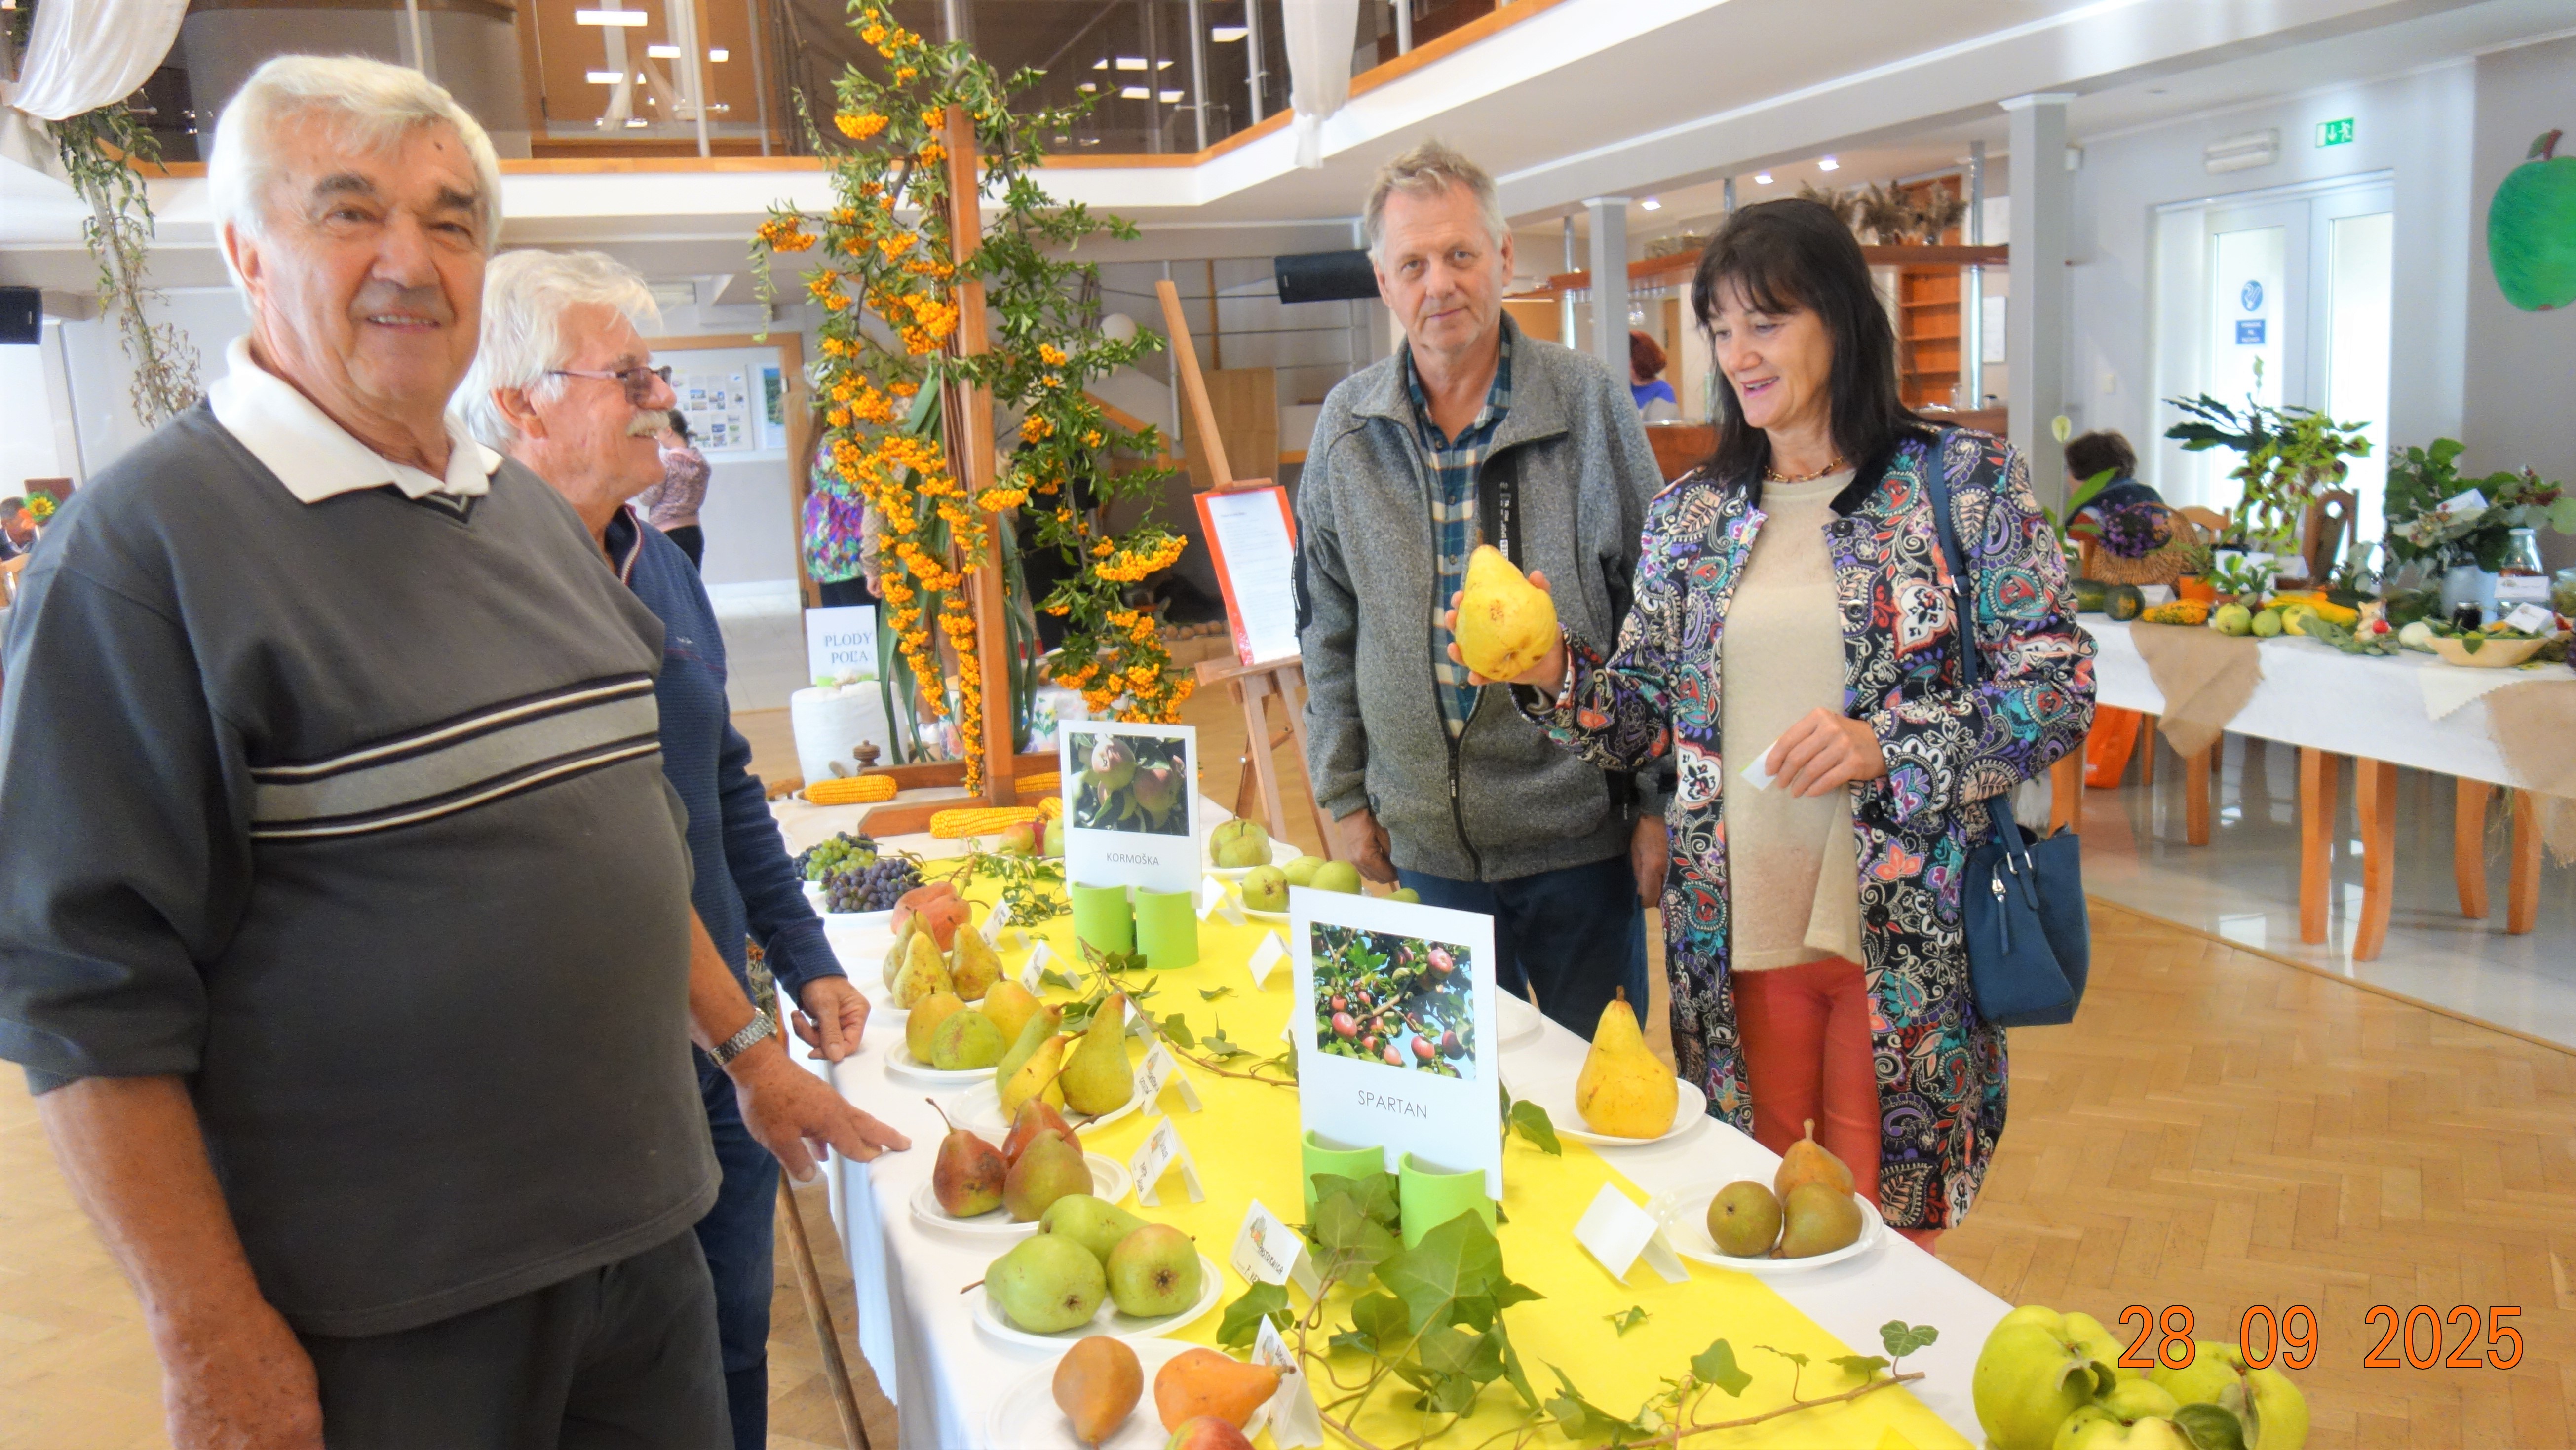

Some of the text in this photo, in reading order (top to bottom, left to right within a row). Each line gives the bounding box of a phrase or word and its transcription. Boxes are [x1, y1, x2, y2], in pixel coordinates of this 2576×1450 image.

[825, 632, 872, 647] PLODY
[831, 650, 869, 663] POĽA
[1107, 852, 1160, 866] KORMOŠKA
[1358, 1090, 1427, 1119] SPARTAN
